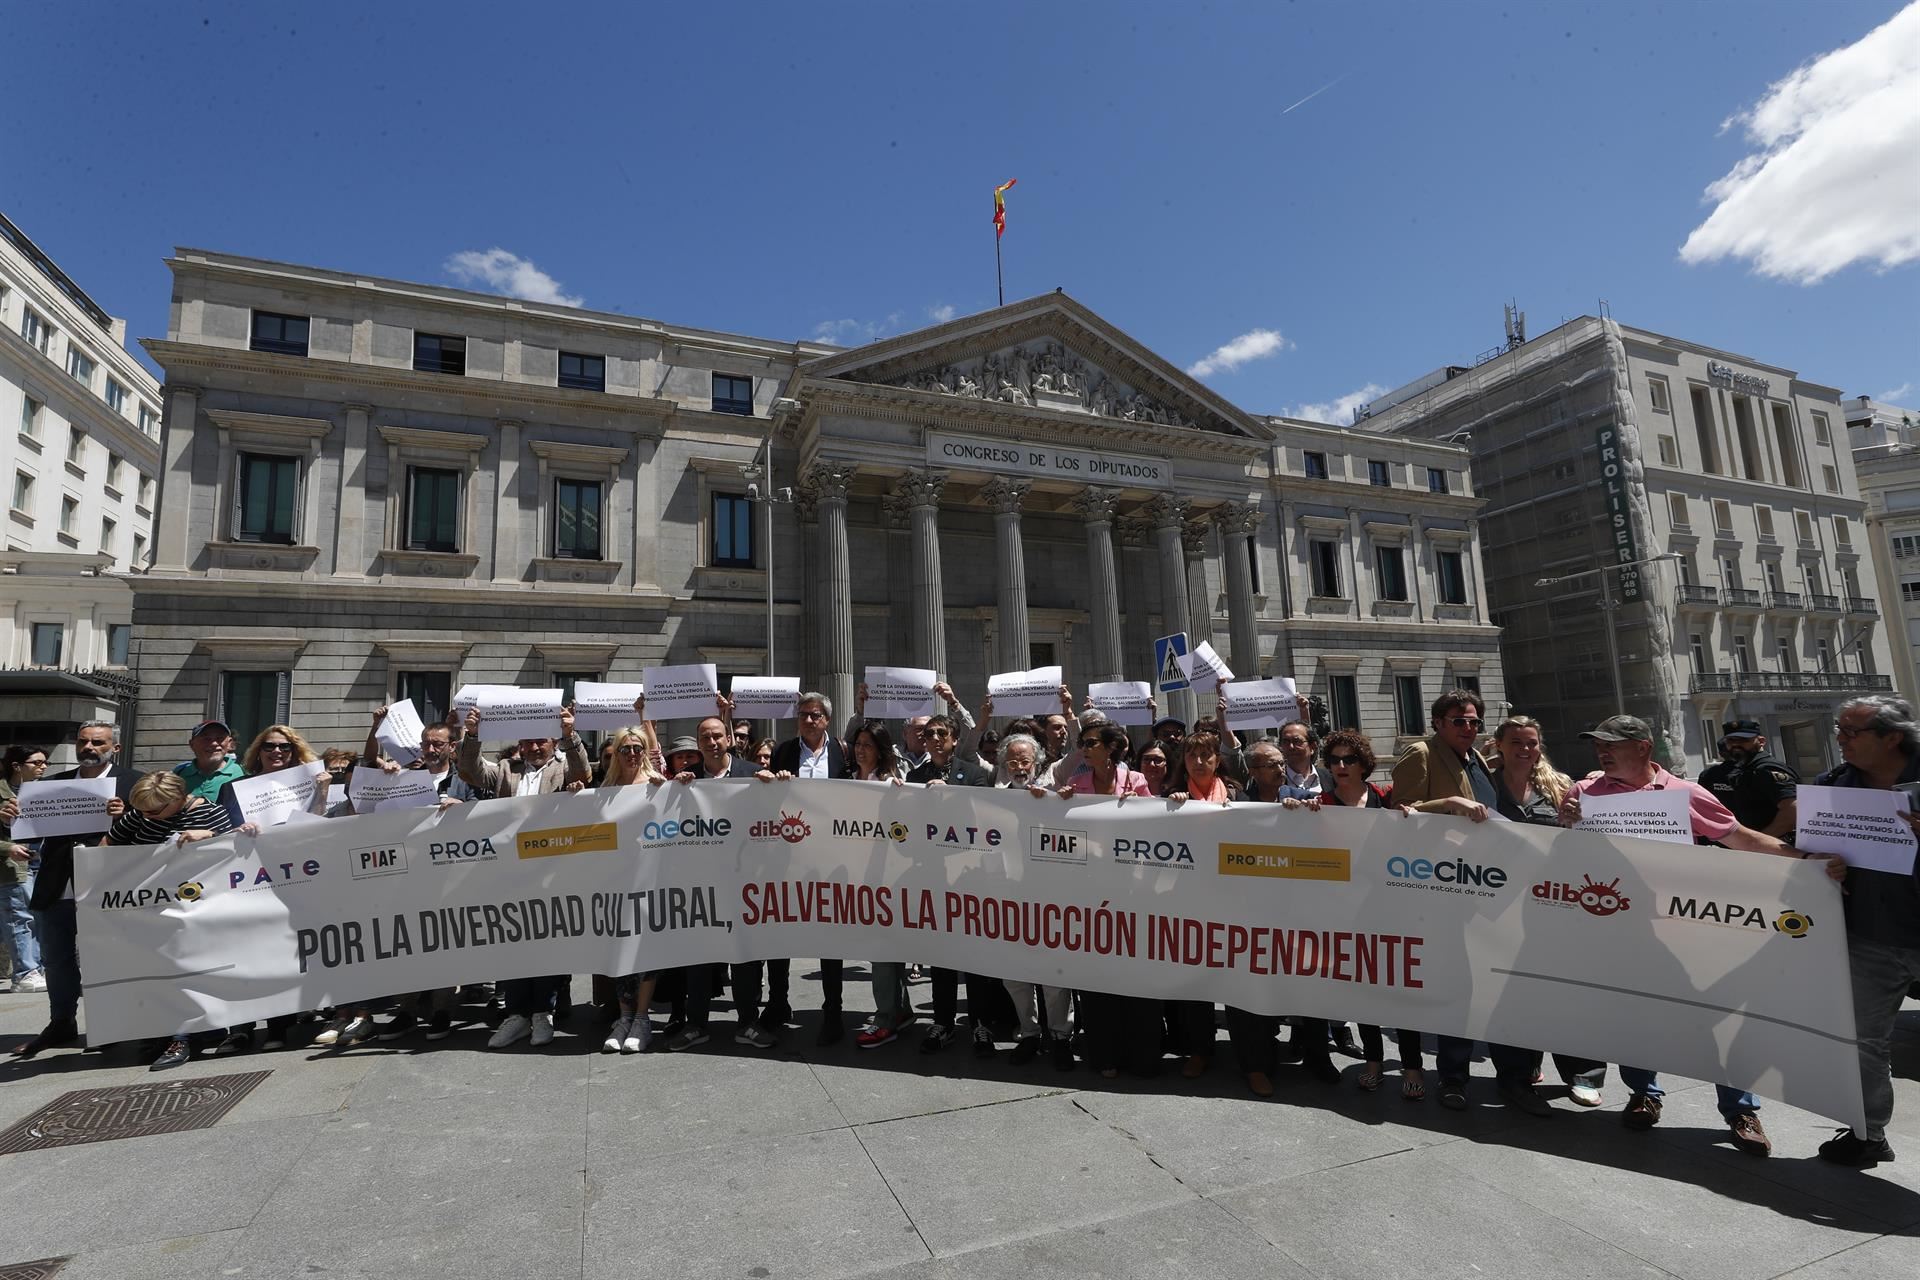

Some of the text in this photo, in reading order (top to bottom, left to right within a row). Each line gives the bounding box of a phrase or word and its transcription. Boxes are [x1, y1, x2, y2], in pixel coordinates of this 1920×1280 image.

[943, 443, 1159, 479] CONGRESO DE LOS DIPUTADOS
[1600, 431, 1632, 562] PROLISER
[1620, 572, 1638, 581] 570
[1625, 588, 1637, 596] 69
[279, 780, 312, 791] DIVERSIDAD
[246, 800, 284, 815] PRODUCCIÓN
[749, 815, 812, 841] diboos
[1846, 813, 1896, 824] DIVERSIDAD
[832, 820, 886, 839] MAPA
[1848, 823, 1893, 834] SALVEMOS
[430, 837, 497, 860] PROA
[524, 838, 573, 850] PROFILM
[1040, 833, 1077, 853] PIAF
[1848, 833, 1914, 846] INDEPENDIENTE
[360, 849, 398, 870] PIAF
[1113, 838, 1195, 863] PROA
[1227, 854, 1289, 867] PROFILM
[101, 887, 171, 910] MAPA
[1430, 884, 1463, 894] estatal
[1478, 890, 1496, 898] cine
[1532, 878, 1631, 914] diboos
[1668, 896, 1767, 929] MAPA
[298, 881, 1424, 988] POR LA DIVERSIDAD CULTURAL, SALVEMOS LA PRODUCCIÓN INDEPENDIENTE
